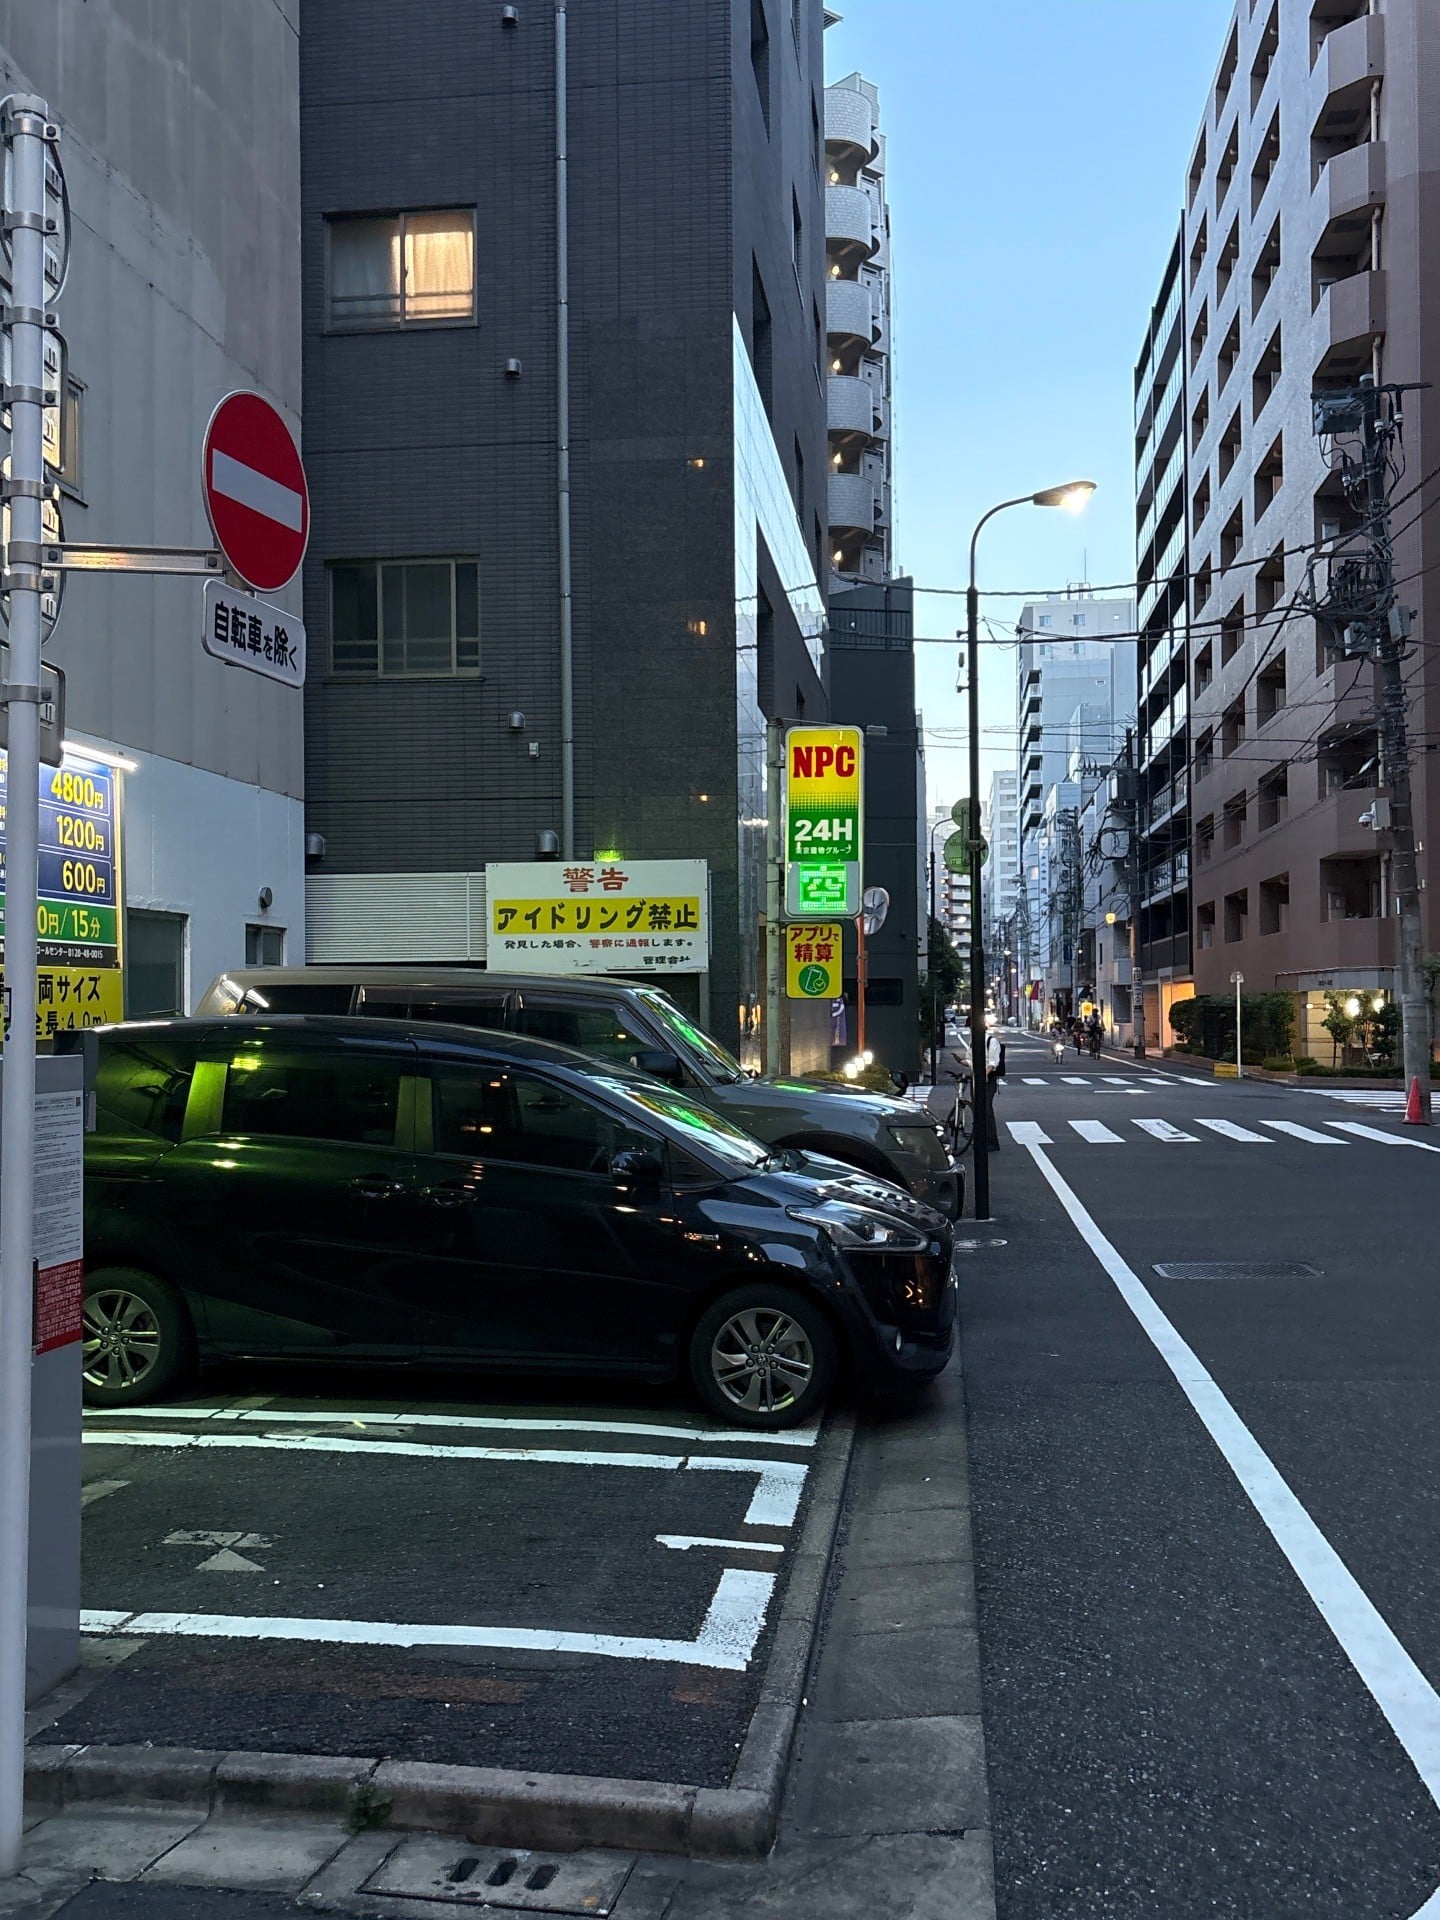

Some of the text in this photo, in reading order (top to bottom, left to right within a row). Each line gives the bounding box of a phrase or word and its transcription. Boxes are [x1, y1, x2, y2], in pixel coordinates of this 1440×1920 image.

[214, 600, 298, 672] 自転車を除く
[793, 746, 856, 778] NPC
[51, 770, 104, 809] 4800円
[56, 814, 104, 851] 1200円
[794, 818, 853, 841] 24H
[62, 860, 105, 894] 600円
[562, 866, 629, 893] 警告
[497, 898, 698, 931] アイドリング禁止
[790, 926, 839, 943] アプリで
[794, 943, 834, 963] 精算
